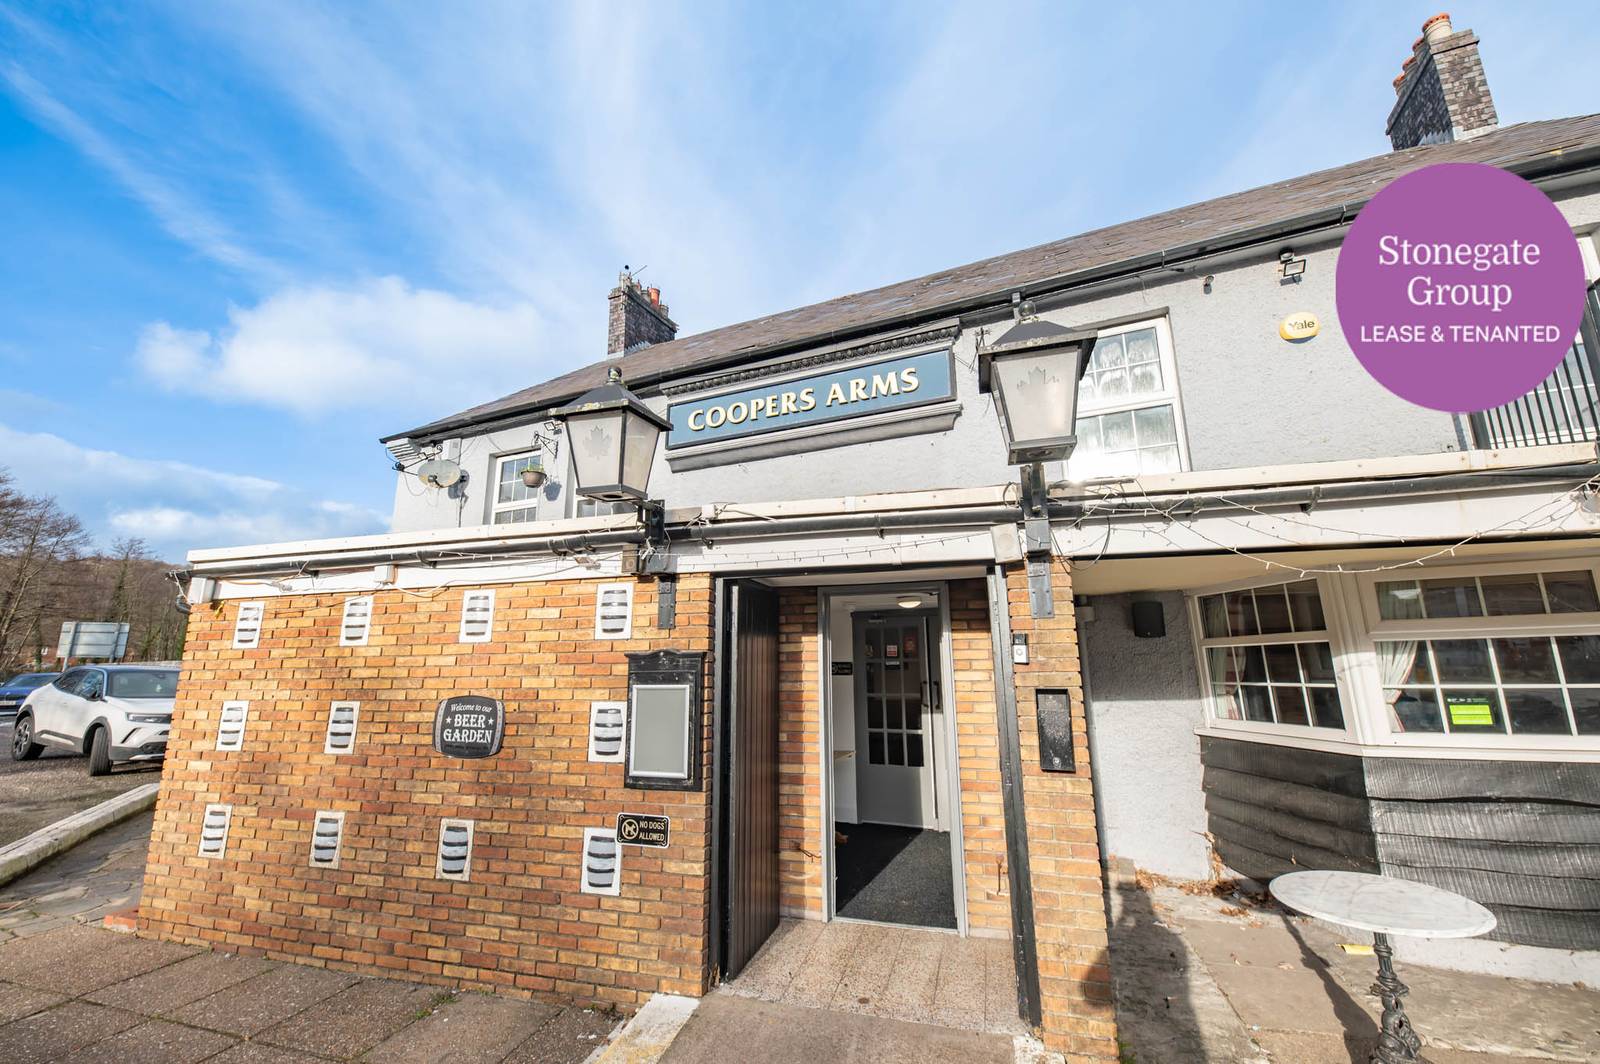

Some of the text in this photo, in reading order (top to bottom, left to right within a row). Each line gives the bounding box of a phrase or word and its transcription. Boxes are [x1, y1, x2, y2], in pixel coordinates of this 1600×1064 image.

[1288, 320, 1315, 329] Yale
[687, 367, 920, 432] COOPERS ARMS
[450, 703, 475, 712] Welcome
[454, 714, 486, 728] BEER
[443, 729, 493, 743] GARDEN
[639, 820, 665, 830] NO DOGS
[639, 832, 665, 841] ALLOWED
